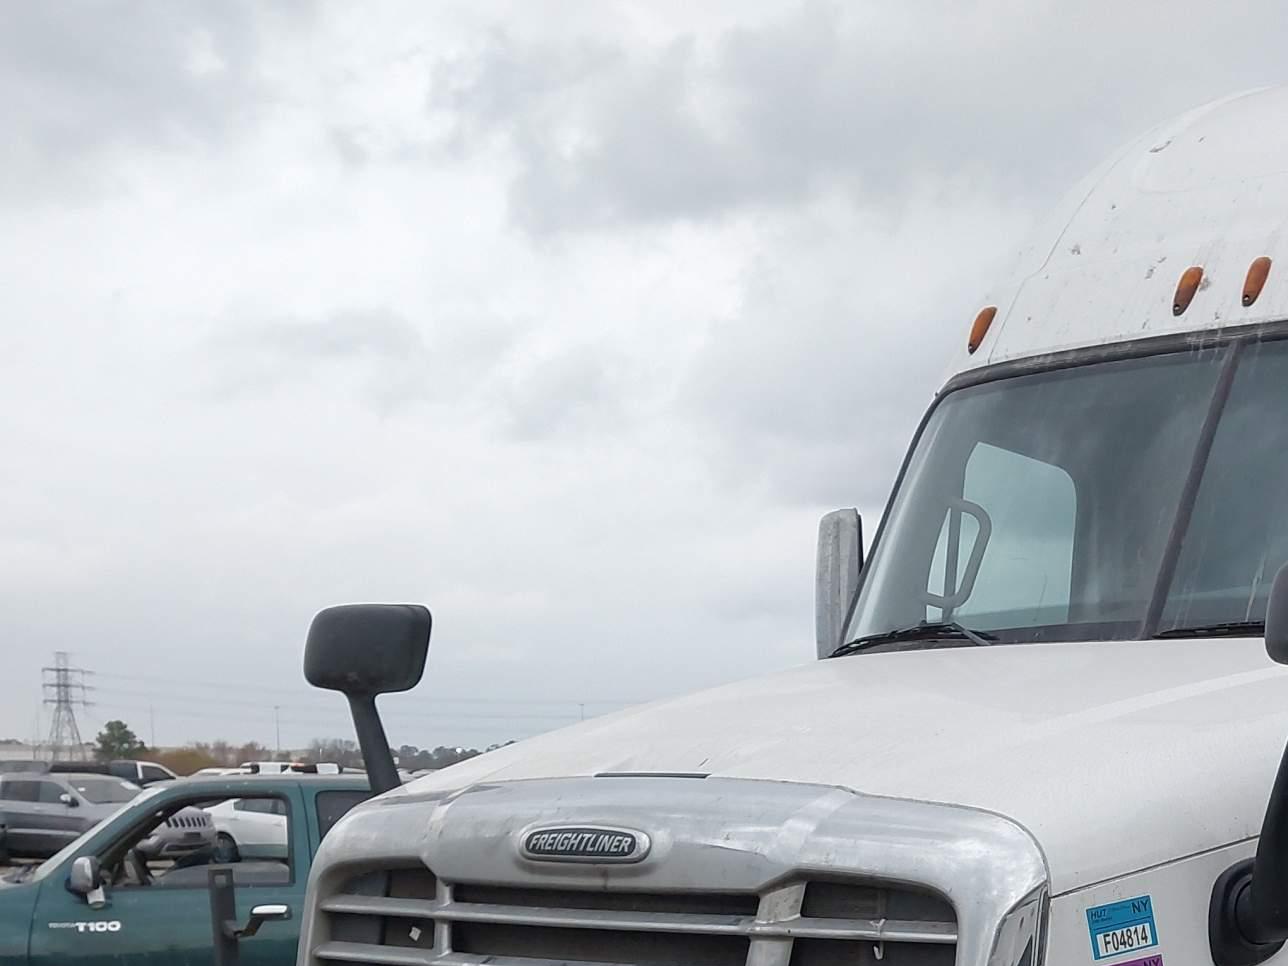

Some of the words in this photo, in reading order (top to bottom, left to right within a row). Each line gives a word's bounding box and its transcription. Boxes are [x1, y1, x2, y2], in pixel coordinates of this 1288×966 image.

[529, 833, 633, 853] FREIGHTLINER
[1091, 909, 1107, 919] HUT
[1131, 901, 1148, 914] NY
[75, 921, 121, 932] T100
[1103, 924, 1148, 953] F04814
